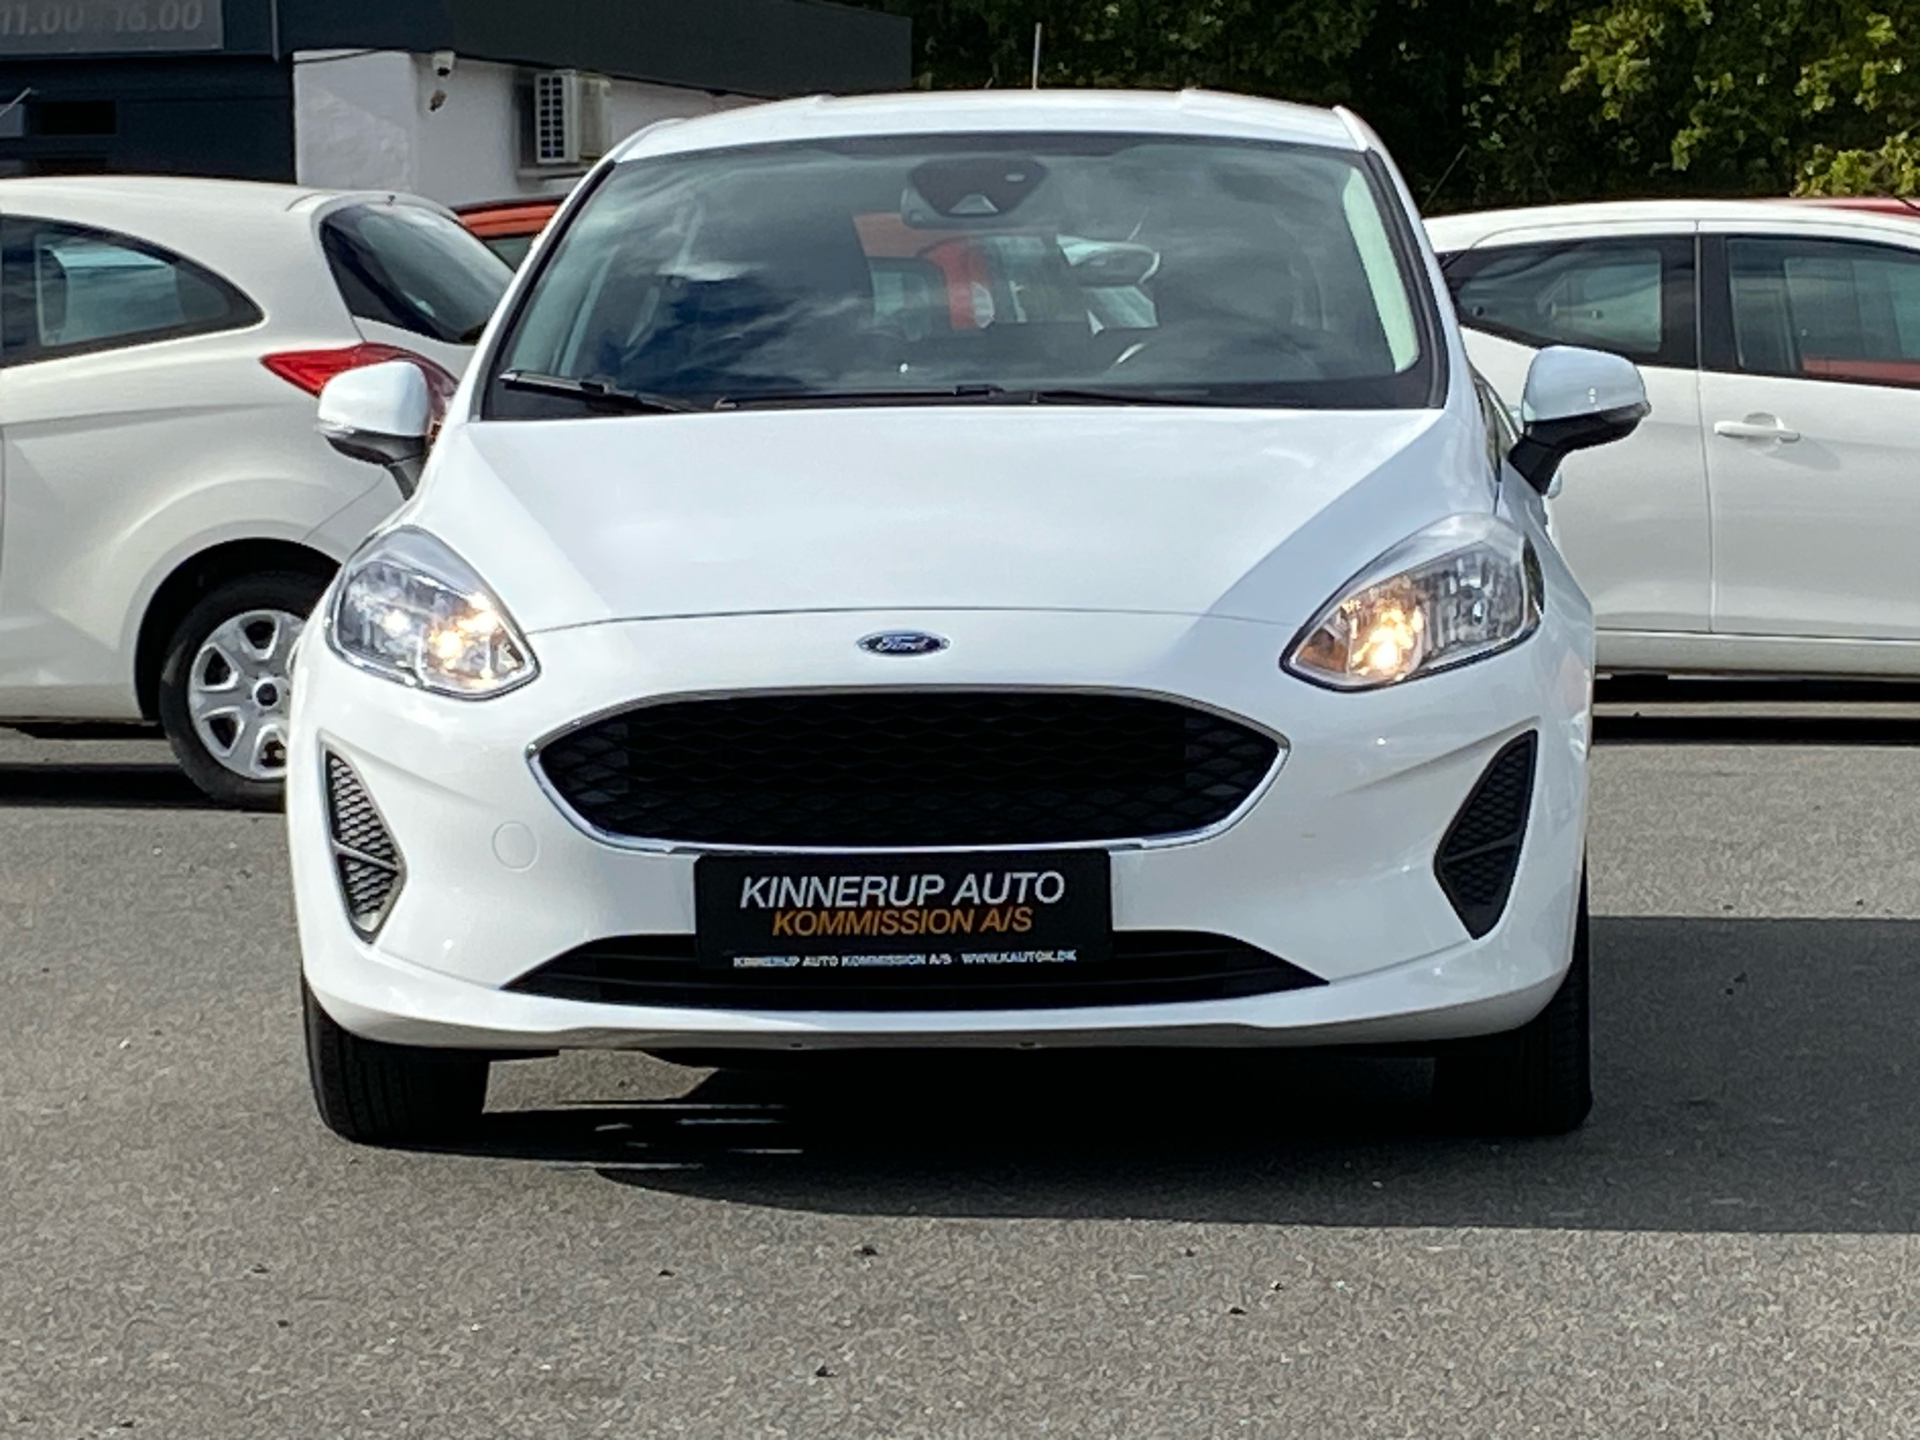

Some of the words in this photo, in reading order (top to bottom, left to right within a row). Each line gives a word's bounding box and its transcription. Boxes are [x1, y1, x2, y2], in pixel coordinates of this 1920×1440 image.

[740, 875, 945, 908] KINNERUP
[952, 871, 1066, 905] AUTO
[773, 909, 973, 935] KOMMISSION
[980, 907, 1033, 932] A/S
[802, 955, 839, 967] AUTO
[929, 953, 952, 965] A/S
